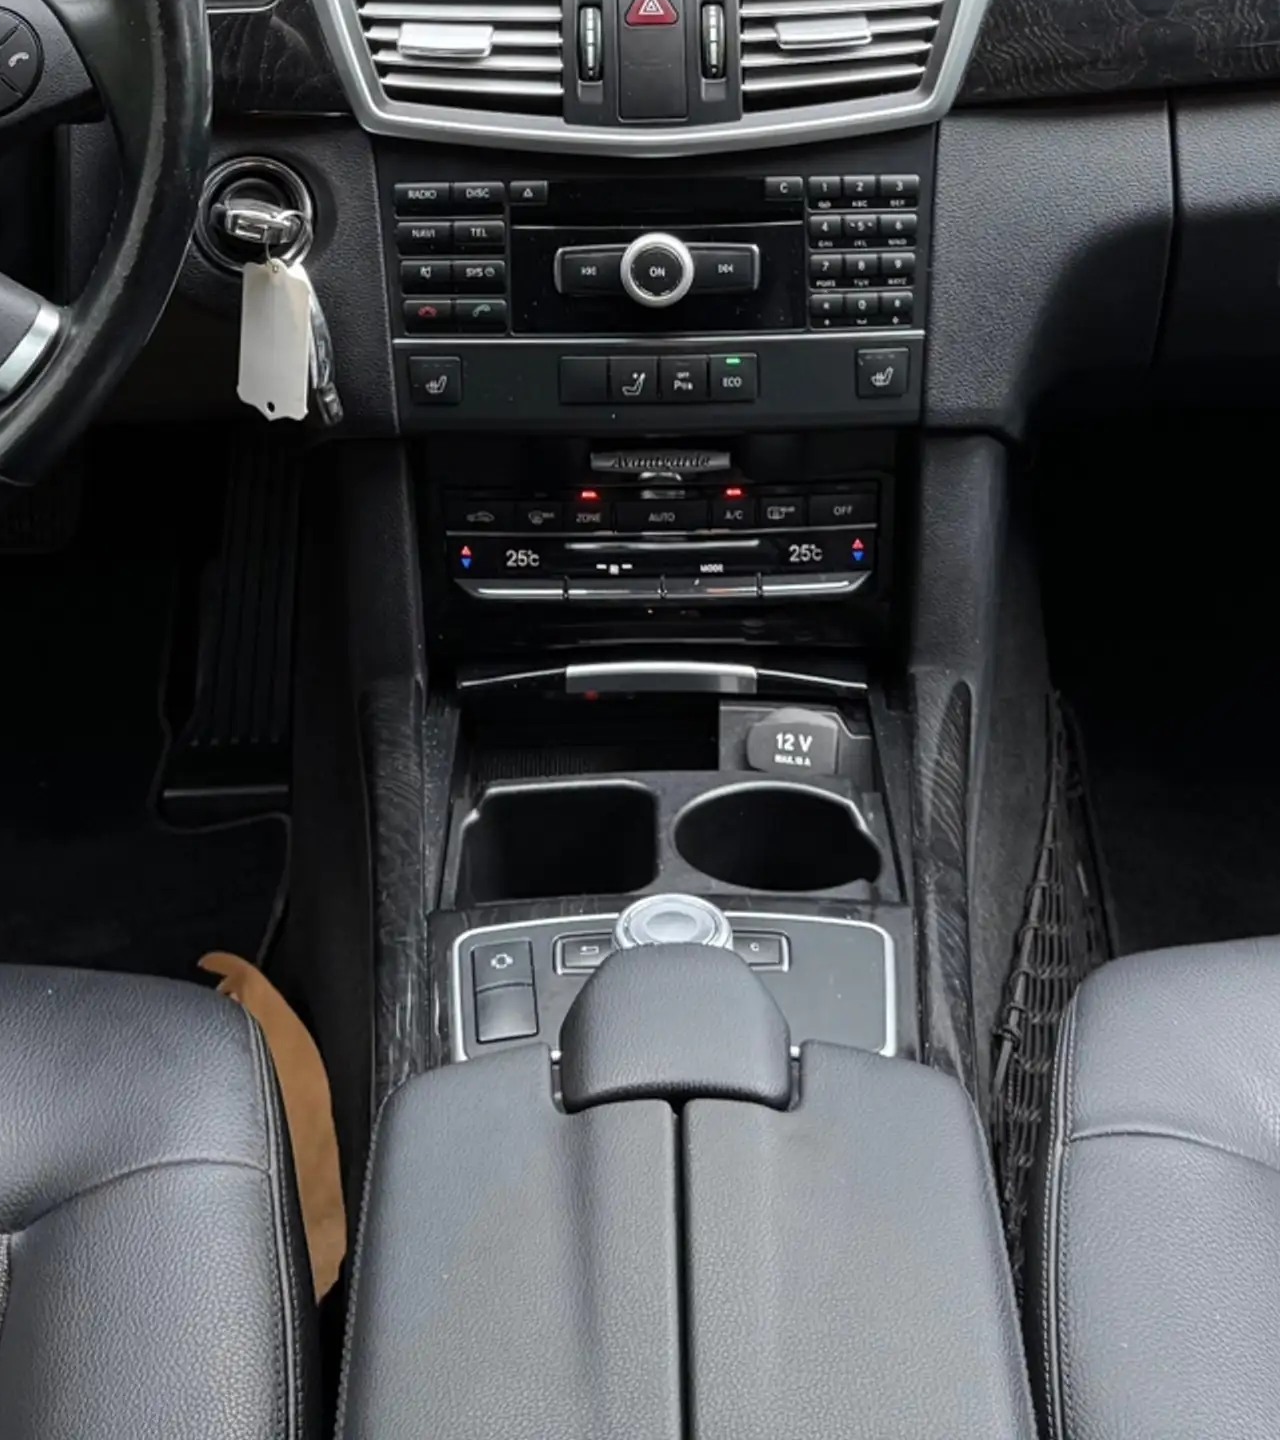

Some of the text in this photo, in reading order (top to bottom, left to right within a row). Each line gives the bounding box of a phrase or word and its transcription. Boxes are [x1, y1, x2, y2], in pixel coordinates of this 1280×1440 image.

[778, 181, 789, 194] C
[855, 181, 865, 192] 2
[894, 179, 903, 192] 3
[407, 189, 438, 200] RADIO
[465, 188, 491, 199] DISC
[470, 227, 488, 238] TEL
[649, 266, 665, 278] ON
[722, 376, 742, 388] ECO
[724, 511, 744, 521] A/C
[833, 505, 854, 516] OFF
[648, 512, 676, 523] AUTO
[775, 732, 813, 753] 12 V
